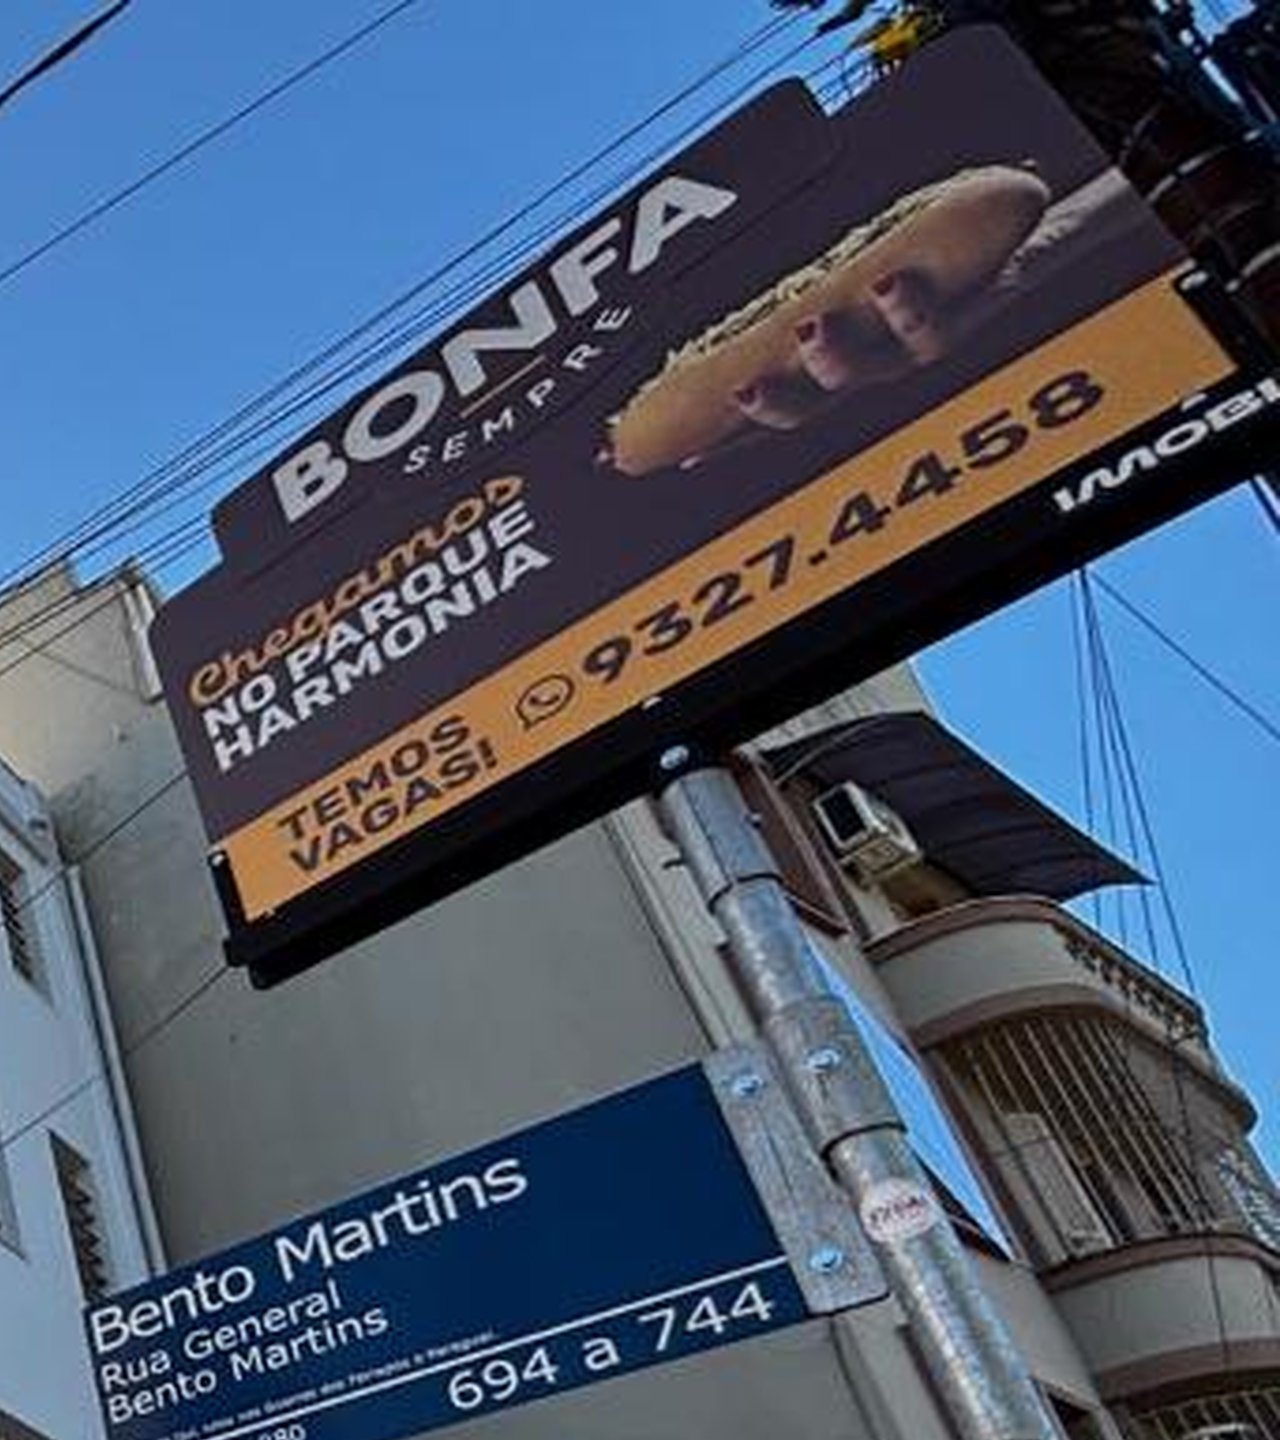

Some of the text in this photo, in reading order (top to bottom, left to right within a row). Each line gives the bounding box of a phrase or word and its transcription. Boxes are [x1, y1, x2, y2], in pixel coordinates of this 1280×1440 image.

[272, 175, 738, 523] BONFA
[402, 306, 631, 475] SEMPRE
[582, 370, 1105, 684] 9327.4458
[203, 500, 535, 736] NO PARQUE
[213, 542, 553, 771] HARMONIA
[277, 715, 470, 838] TEMOS
[290, 740, 498, 872] VAGAS!
[90, 1157, 528, 1354] Bento Martins
[101, 1280, 342, 1392] Rua General
[108, 1367, 217, 1424] Bento
[230, 1306, 388, 1382] Martins
[448, 1347, 560, 1410] 694
[583, 1335, 621, 1371] a
[639, 1282, 774, 1351] 744
